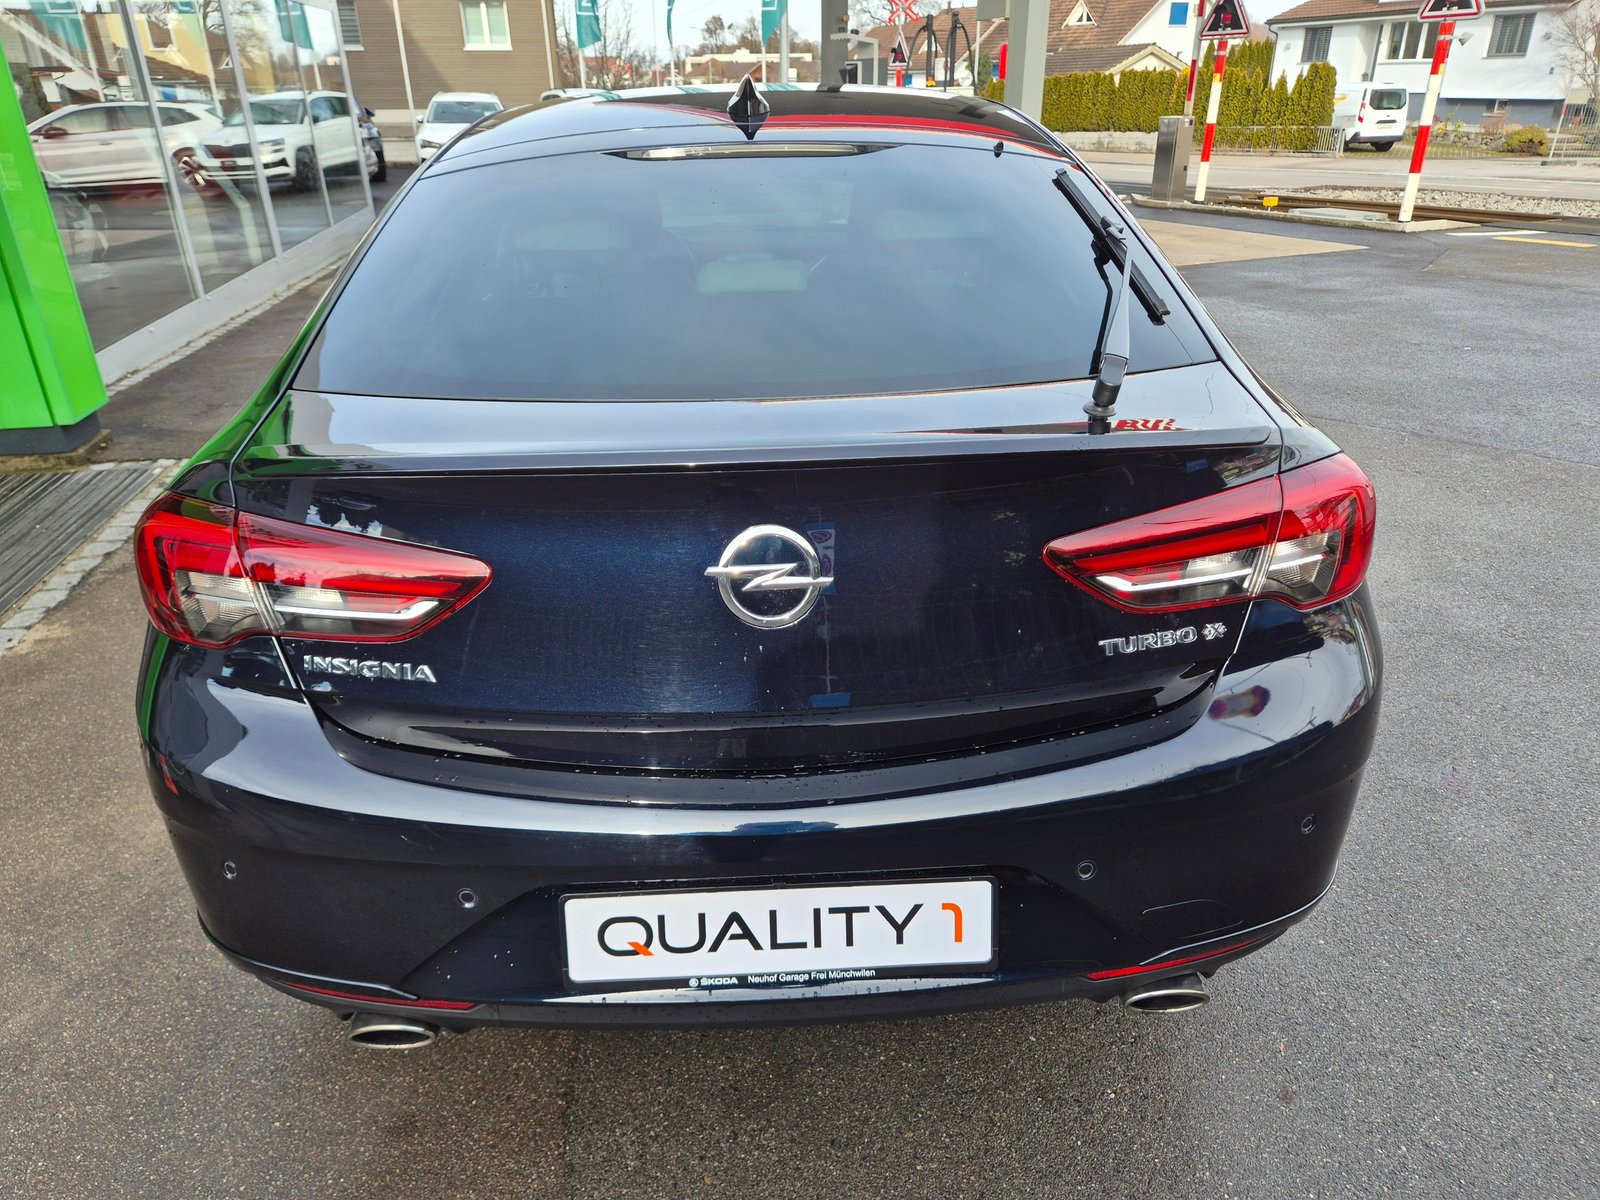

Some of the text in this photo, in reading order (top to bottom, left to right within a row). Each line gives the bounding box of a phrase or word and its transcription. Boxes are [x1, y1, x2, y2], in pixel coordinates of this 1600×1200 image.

[1098, 626, 1198, 656] TURBO
[303, 654, 437, 683] INSIGNIA
[597, 902, 963, 957] QUALITY 1
[747, 974, 778, 984] Neuhof
[779, 971, 809, 983] Garage
[811, 971, 827, 980] Frei
[828, 969, 876, 979] Münchwilen
